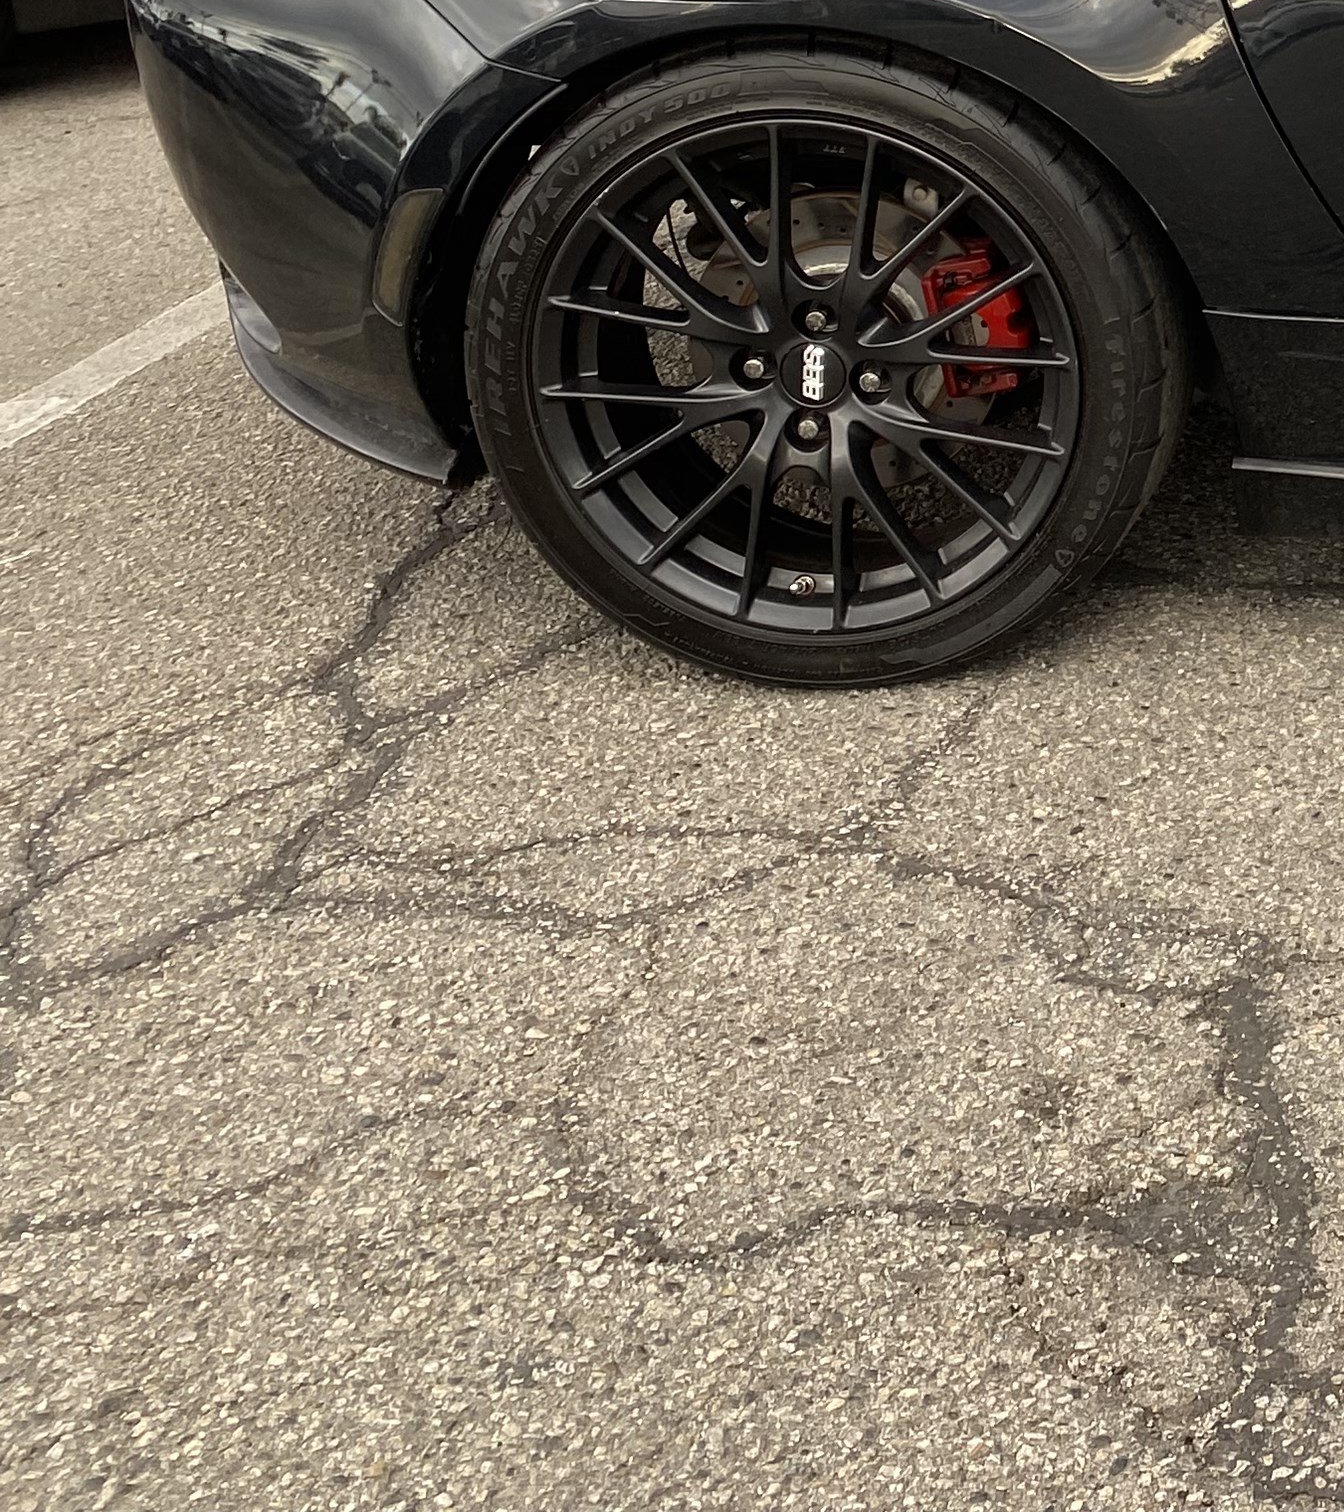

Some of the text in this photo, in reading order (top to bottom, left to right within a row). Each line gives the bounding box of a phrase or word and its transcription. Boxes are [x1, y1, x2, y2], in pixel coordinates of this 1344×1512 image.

[586, 83, 733, 160] INDY 500
[802, 344, 825, 401] BBS
